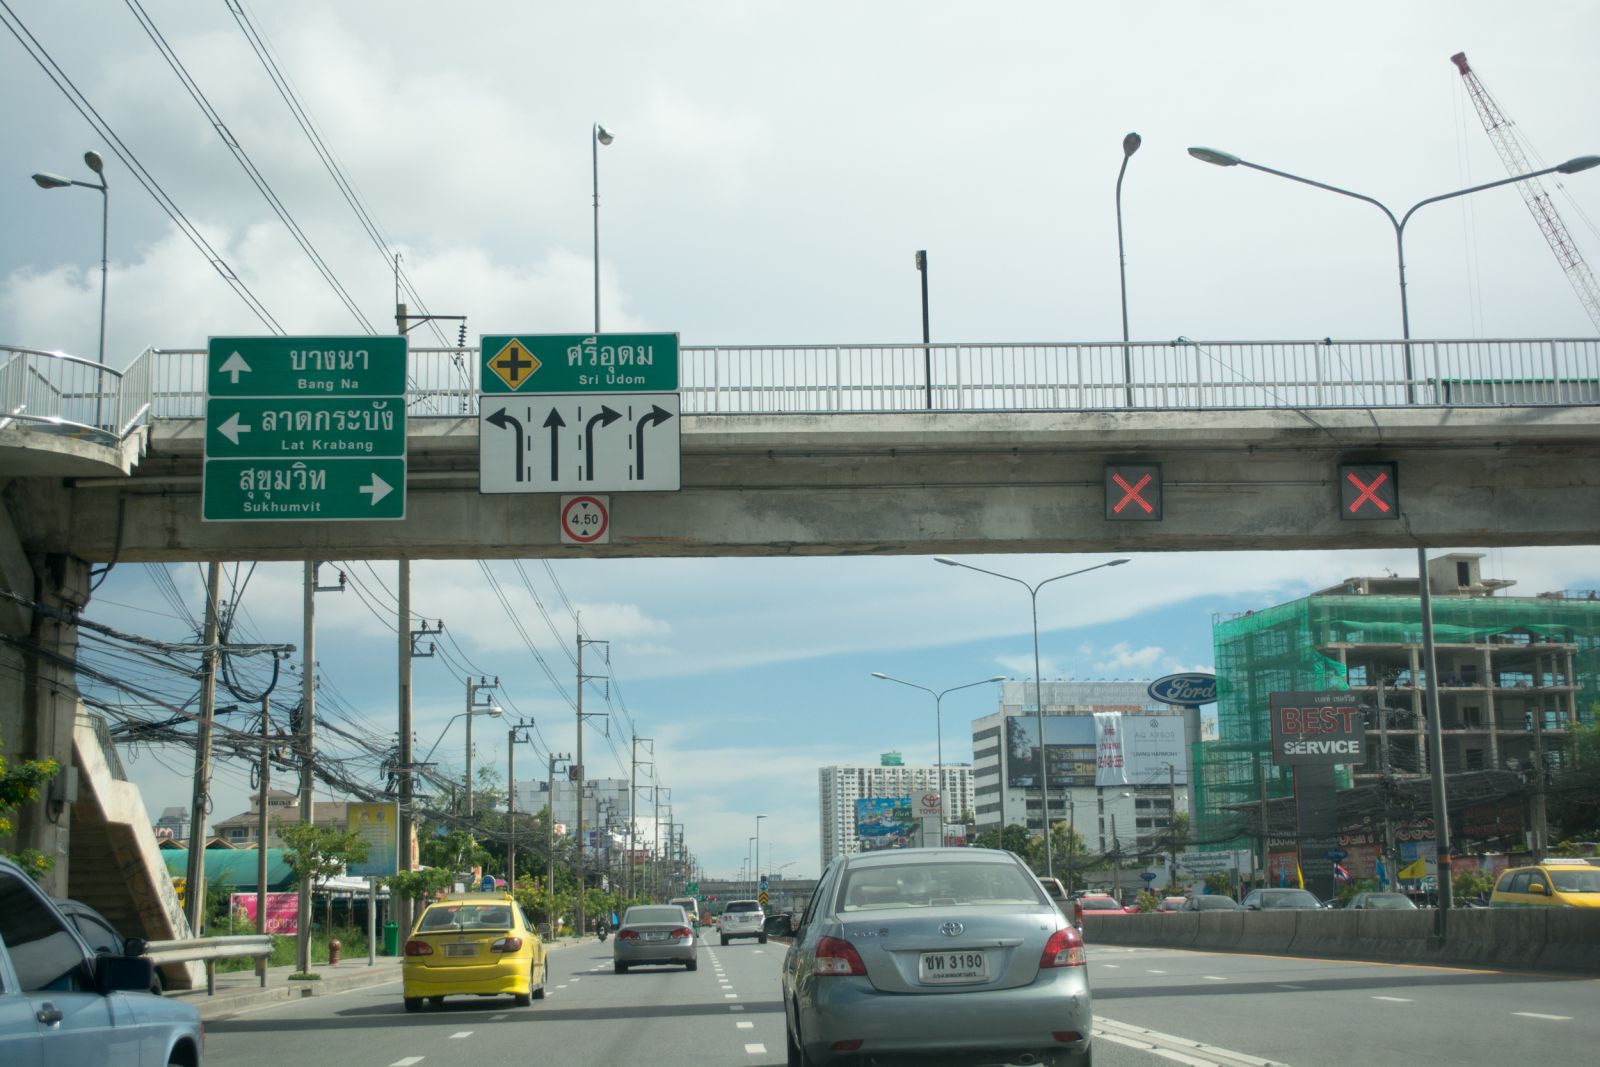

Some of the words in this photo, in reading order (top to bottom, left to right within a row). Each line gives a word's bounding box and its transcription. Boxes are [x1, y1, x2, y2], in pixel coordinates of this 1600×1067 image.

[290, 350, 369, 370] บางนา
[566, 337, 653, 374] ศรีอุดม
[298, 379, 334, 391] Bang
[341, 379, 359, 389] Na
[579, 374, 599, 385] Sri
[606, 374, 646, 385] Udom
[261, 401, 394, 431] ลาดกระบัง
[281, 440, 304, 450] Lat
[312, 440, 373, 452] Krabang
[239, 461, 326, 499] สุขุมวิท
[243, 502, 321, 512] Sukhumvit
[571, 514, 598, 525] 4.50
[1166, 678, 1215, 699] Ford
[1280, 706, 1358, 734] BEST
[1283, 740, 1360, 755] SERVICE
